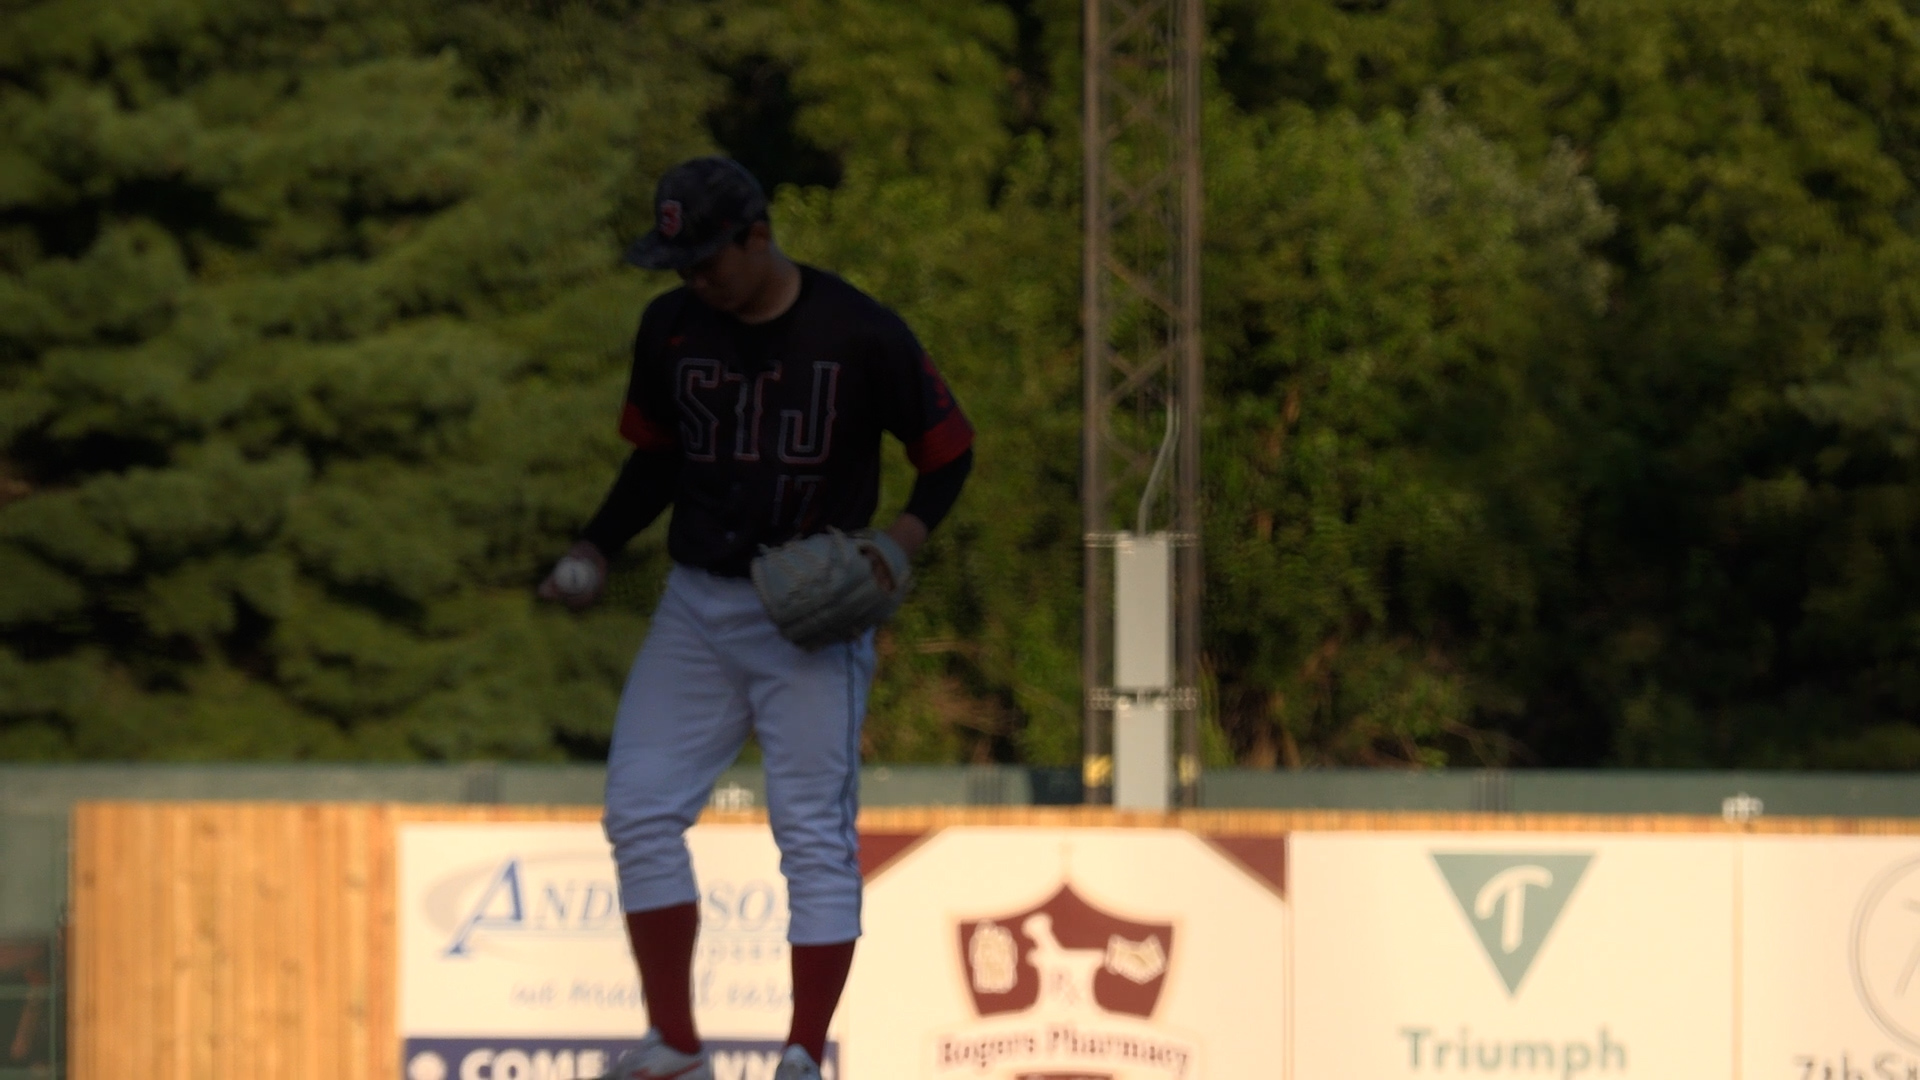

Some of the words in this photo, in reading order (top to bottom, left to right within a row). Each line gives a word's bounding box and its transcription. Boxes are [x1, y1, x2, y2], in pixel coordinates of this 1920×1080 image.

[674, 357, 840, 464] STJ
[771, 473, 828, 533] 17
[438, 857, 786, 958] ANDSO
[1475, 864, 1553, 954] T
[936, 1033, 1036, 1072] Rogers
[1044, 1020, 1191, 1078] Pharmacy
[1398, 1023, 1630, 1080] Triumph
